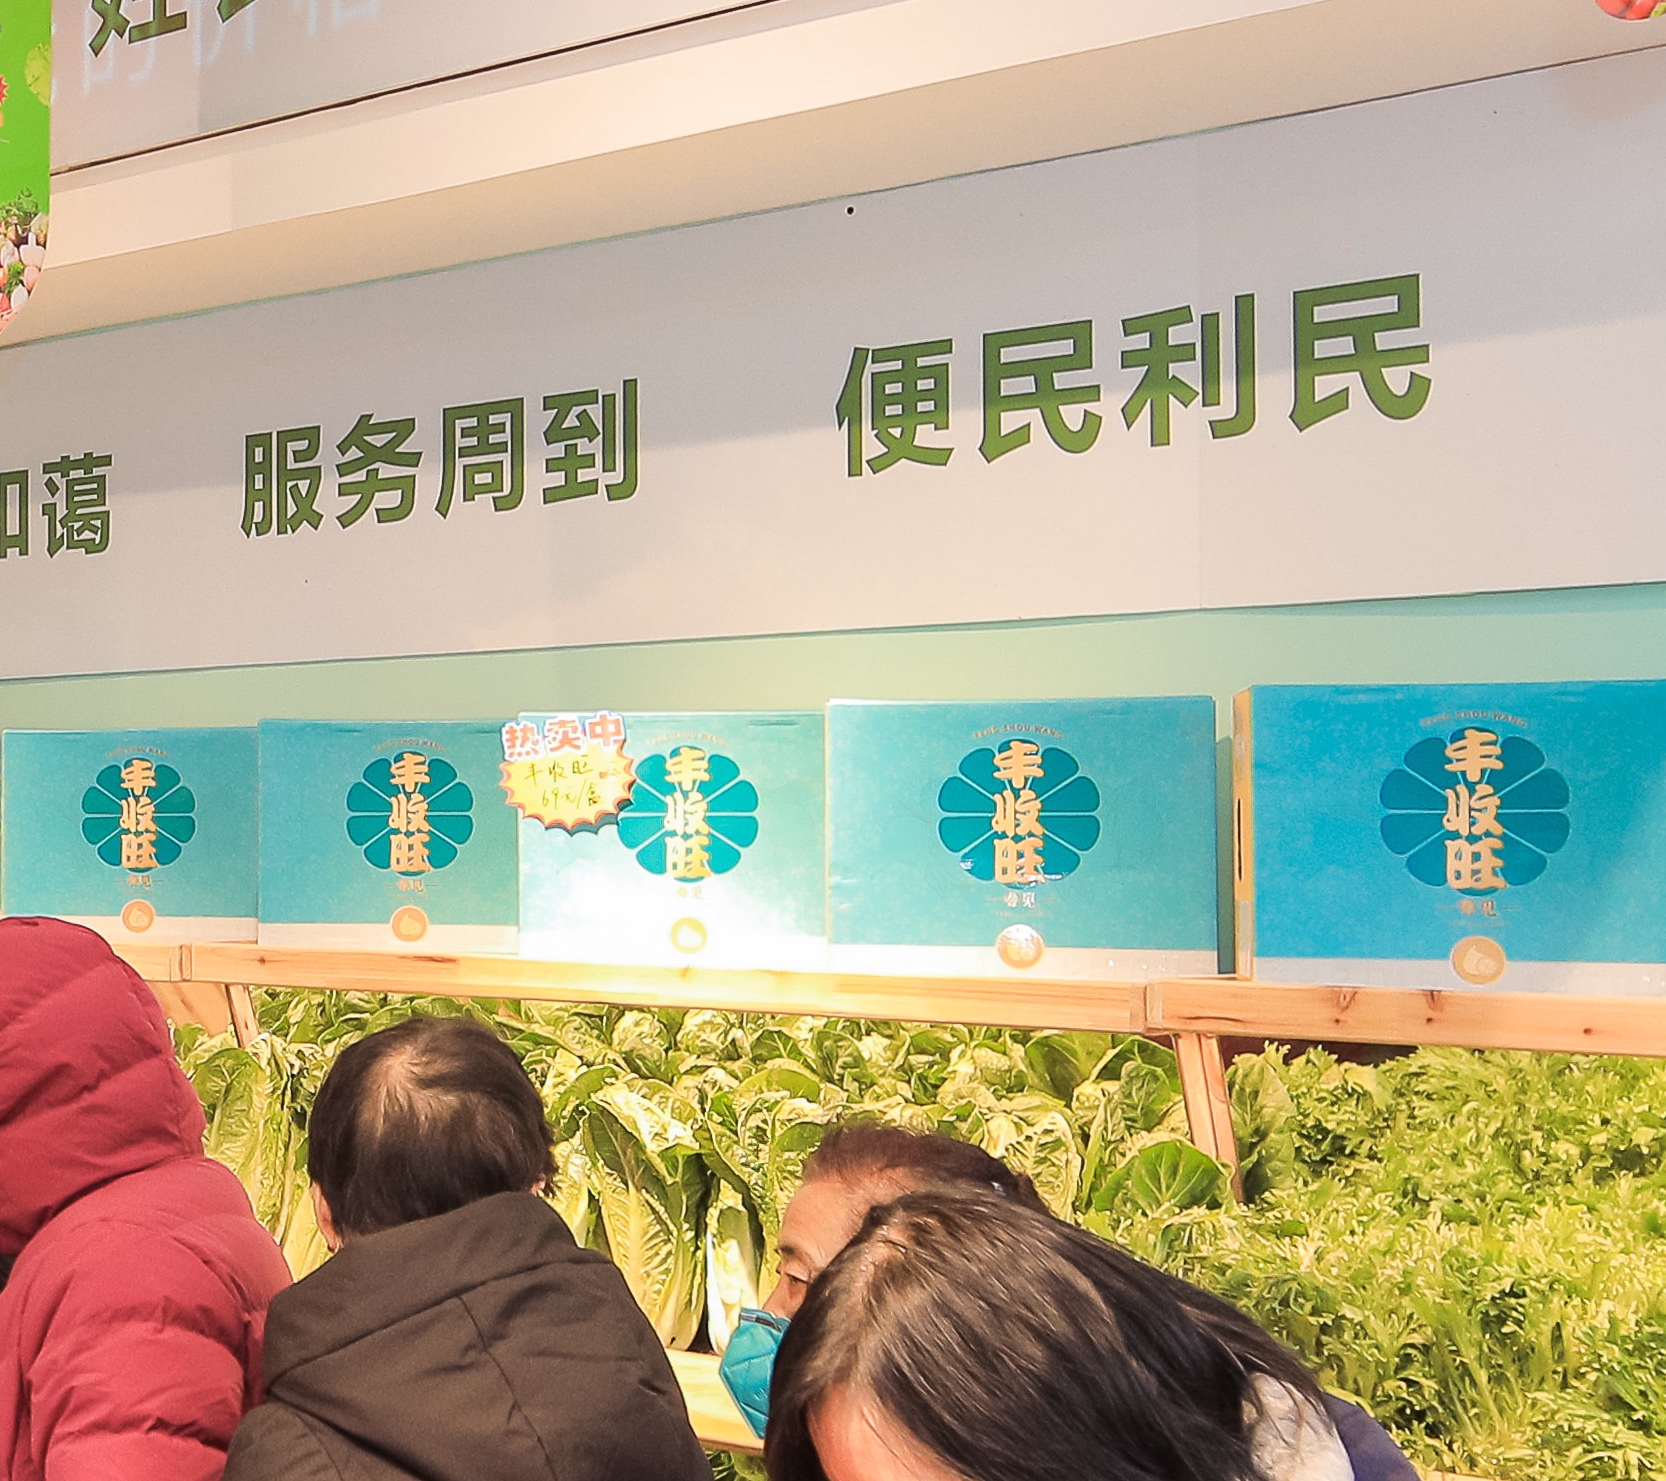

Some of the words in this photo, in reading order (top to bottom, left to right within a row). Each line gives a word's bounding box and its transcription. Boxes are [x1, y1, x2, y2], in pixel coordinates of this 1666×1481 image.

[835, 273, 1433, 478] 便民利民
[240, 377, 642, 539] 服务周到
[504, 714, 625, 759] 热卖中
[524, 755, 594, 785] 丰收旺
[119, 758, 158, 871] 丰收旺
[389, 751, 432, 873] 丰收旺
[664, 747, 712, 881] 丰收旺
[992, 737, 1047, 887] 丰收旺
[1443, 728, 1508, 891] 丰收旺
